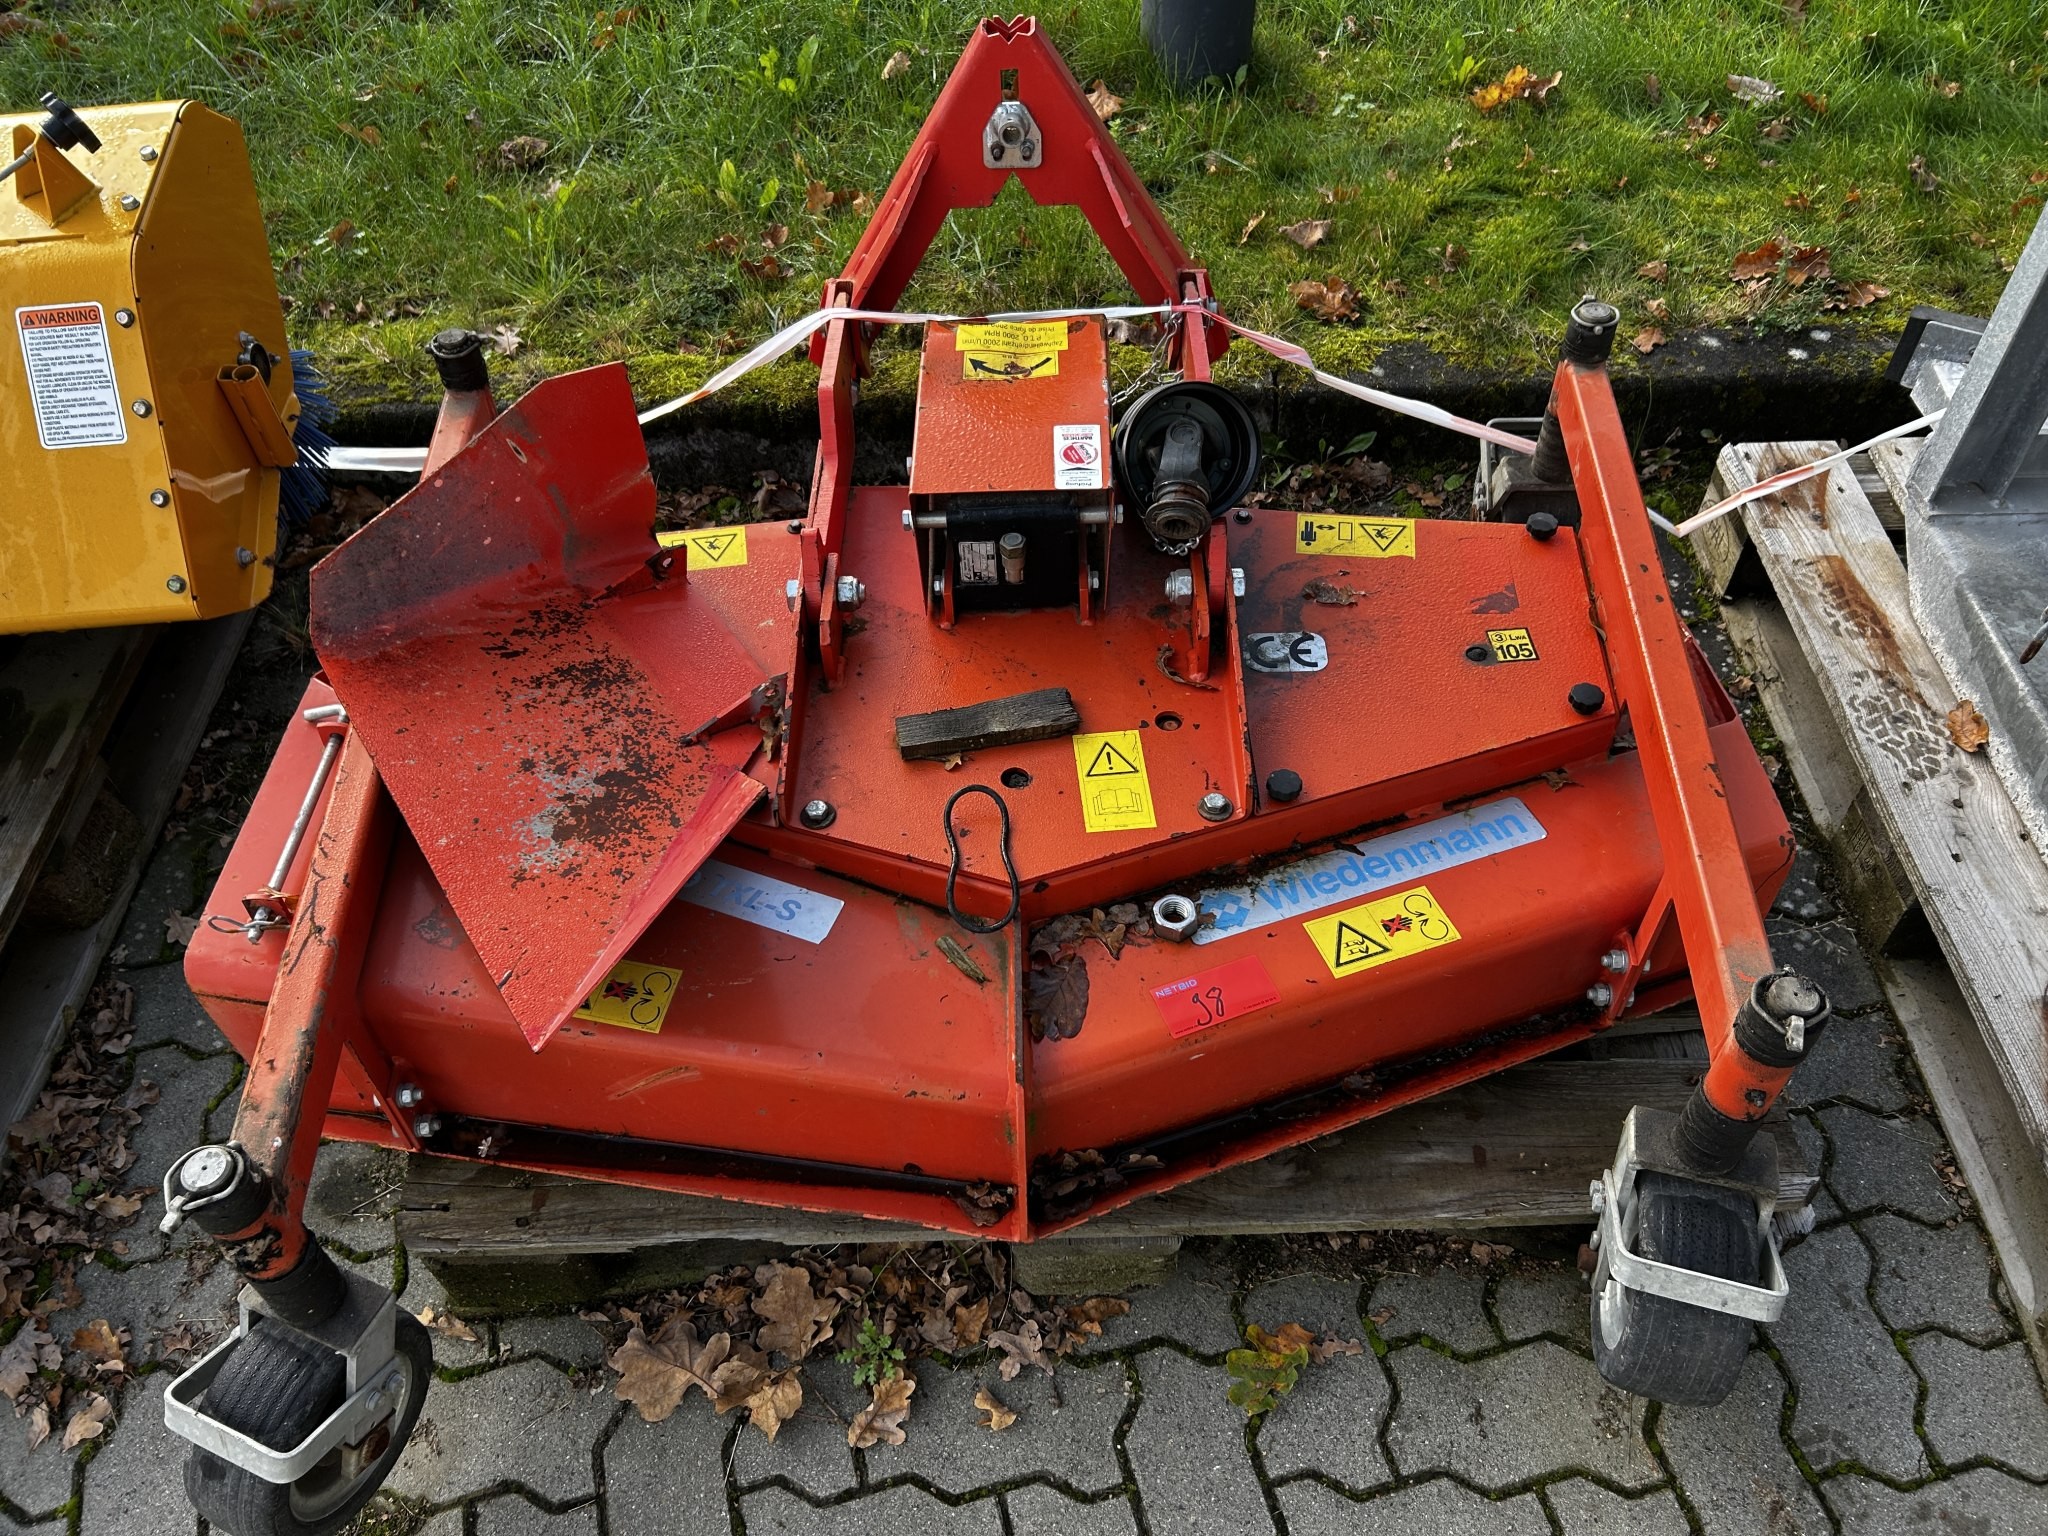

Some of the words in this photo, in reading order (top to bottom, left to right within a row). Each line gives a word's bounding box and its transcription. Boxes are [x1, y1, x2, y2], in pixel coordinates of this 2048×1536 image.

[35, 309, 98, 324] WARNING
[983, 338, 1001, 346] 2000
[1002, 331, 1020, 340] 2000
[1494, 633, 1504, 642] 3
[1495, 643, 1534, 660] 105
[1256, 812, 1529, 911] Wiedenmann
[1155, 979, 1198, 998] NETBID
